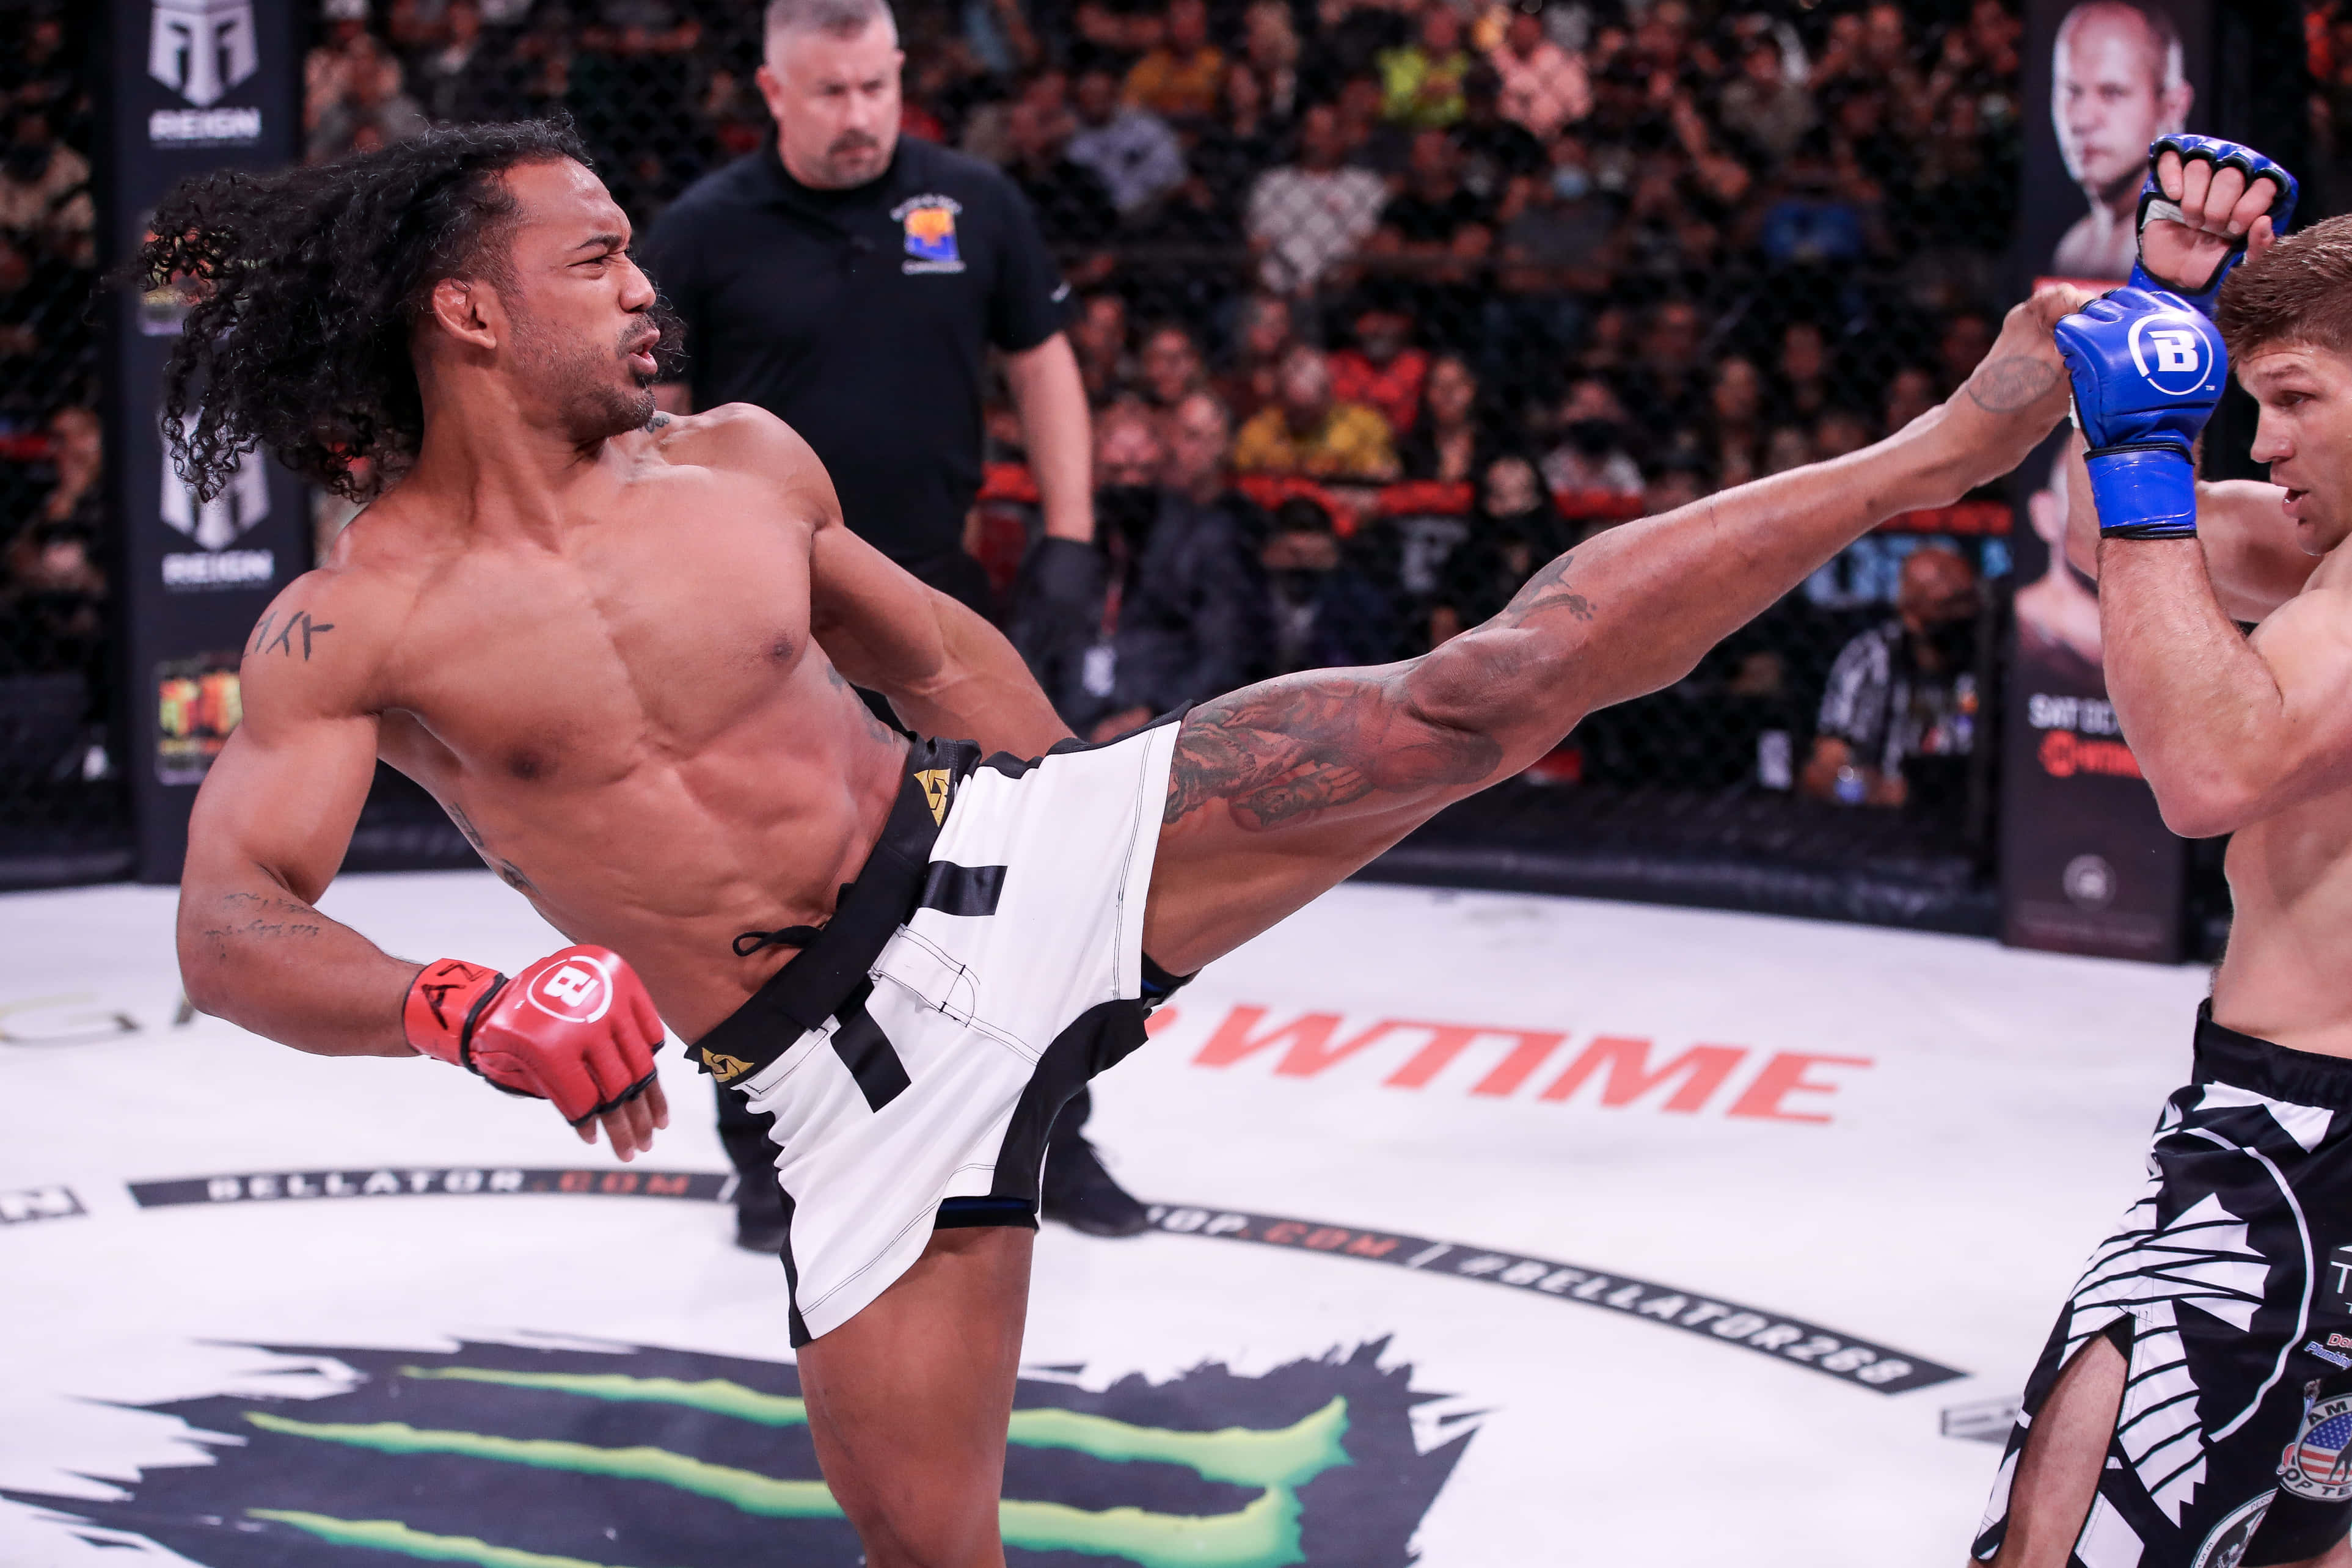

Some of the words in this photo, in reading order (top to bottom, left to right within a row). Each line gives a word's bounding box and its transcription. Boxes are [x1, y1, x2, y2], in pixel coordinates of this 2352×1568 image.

[2147, 330, 2199, 372] B
[543, 966, 599, 1007] B
[1144, 1003, 1874, 1125] WTIME
[2307, 1401, 2348, 1426] AM
